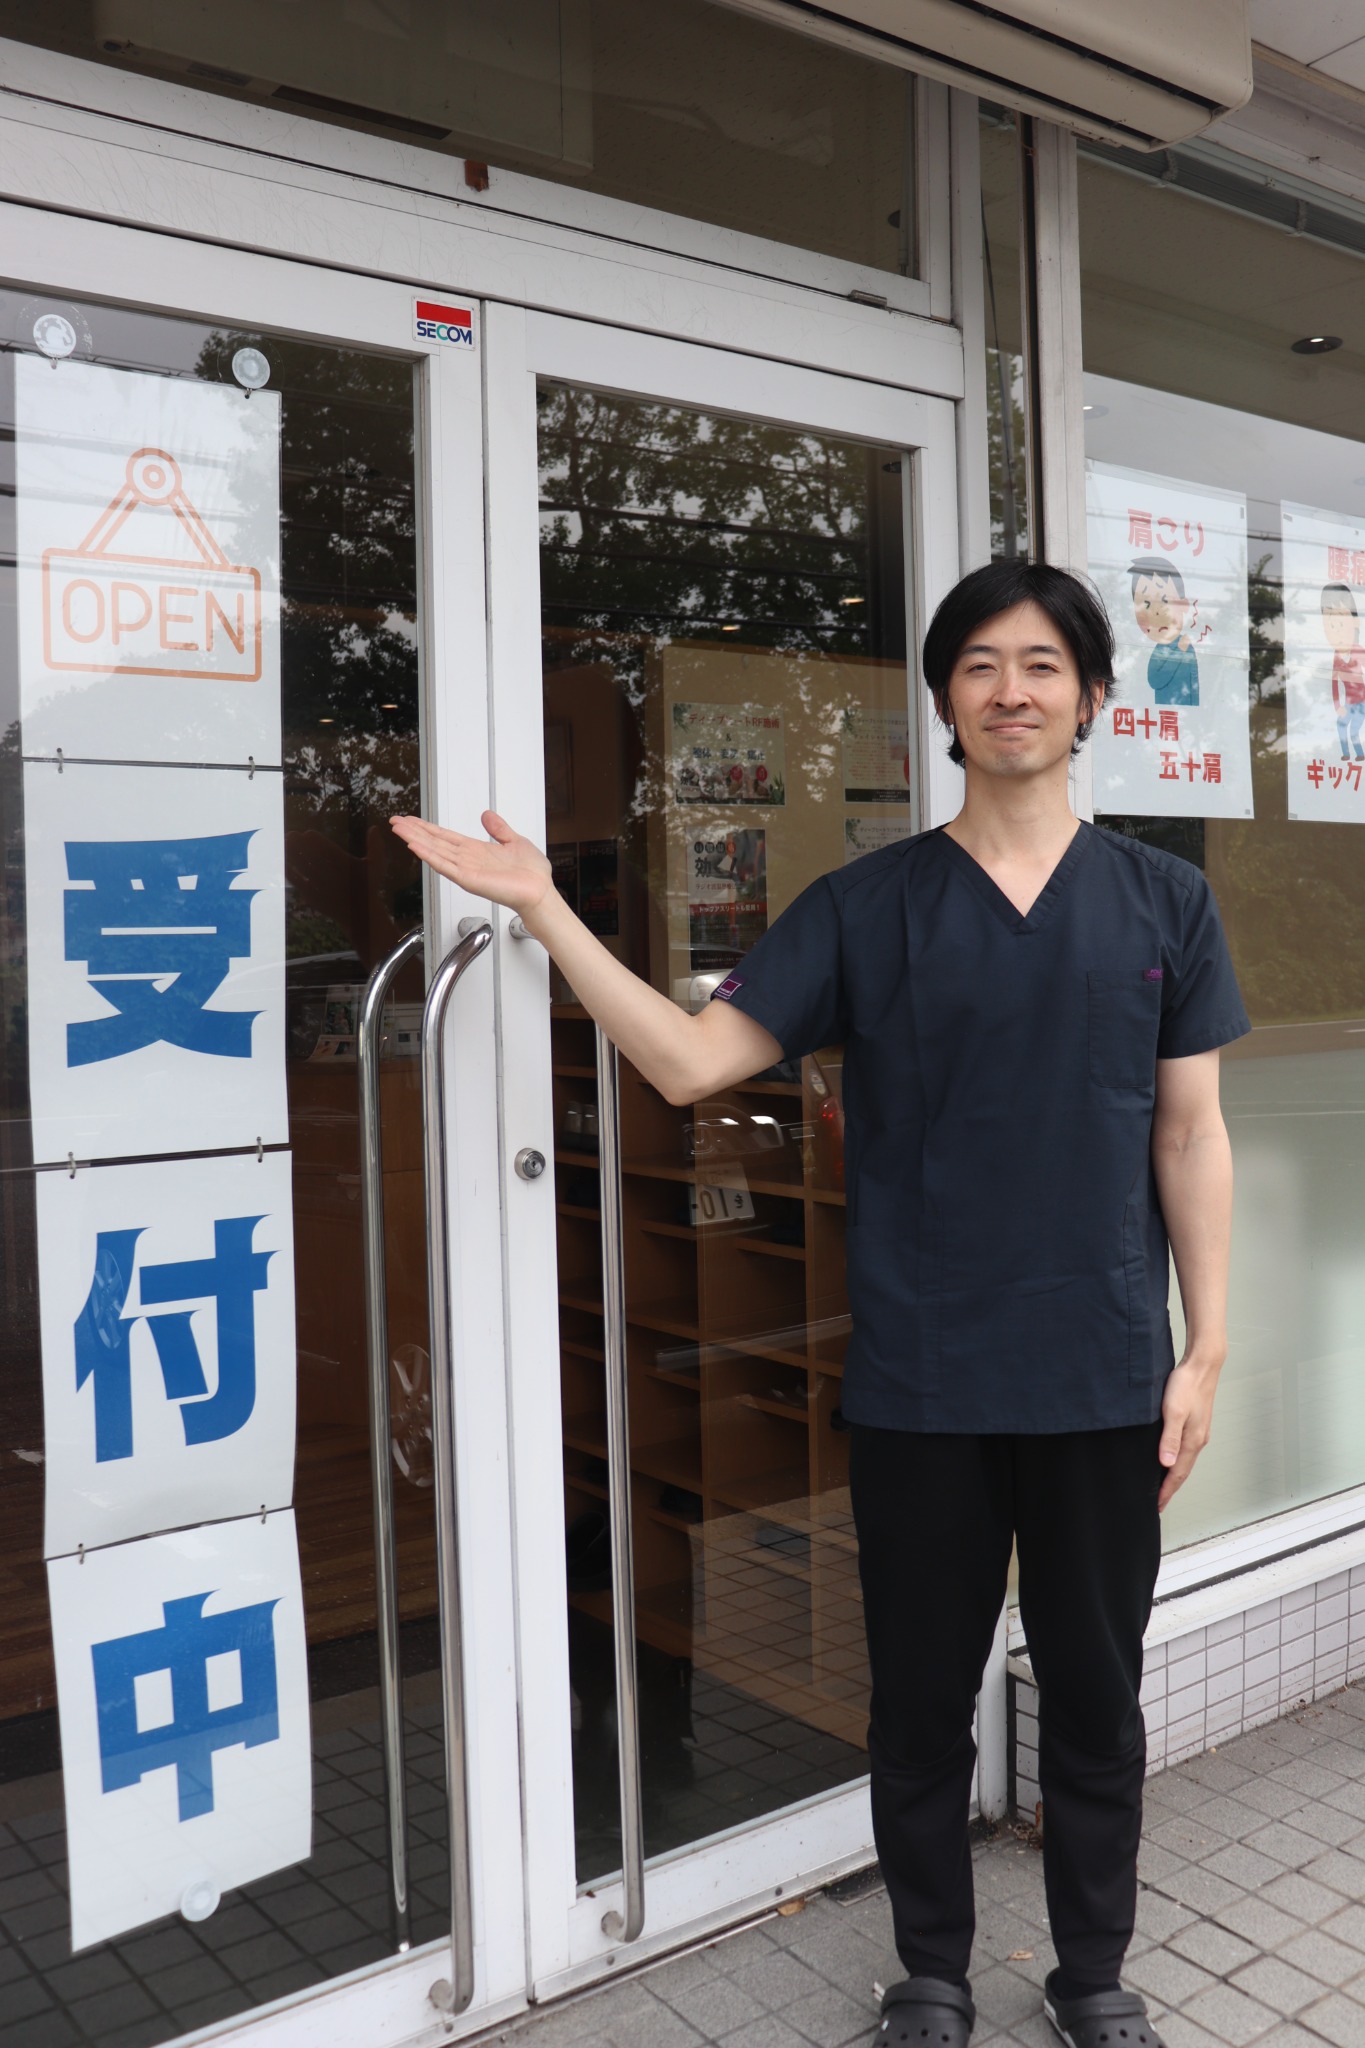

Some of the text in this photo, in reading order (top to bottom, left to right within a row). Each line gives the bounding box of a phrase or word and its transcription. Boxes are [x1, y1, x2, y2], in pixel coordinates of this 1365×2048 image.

[416, 320, 473, 346] SECOM
[1127, 508, 1205, 556] 肩こり
[62, 578, 246, 655] OPEN
[1113, 707, 1180, 742] 四十肩
[1158, 750, 1222, 785] 五十肩
[1307, 758, 1362, 791] ギック
[63, 828, 284, 1823] 受付中
